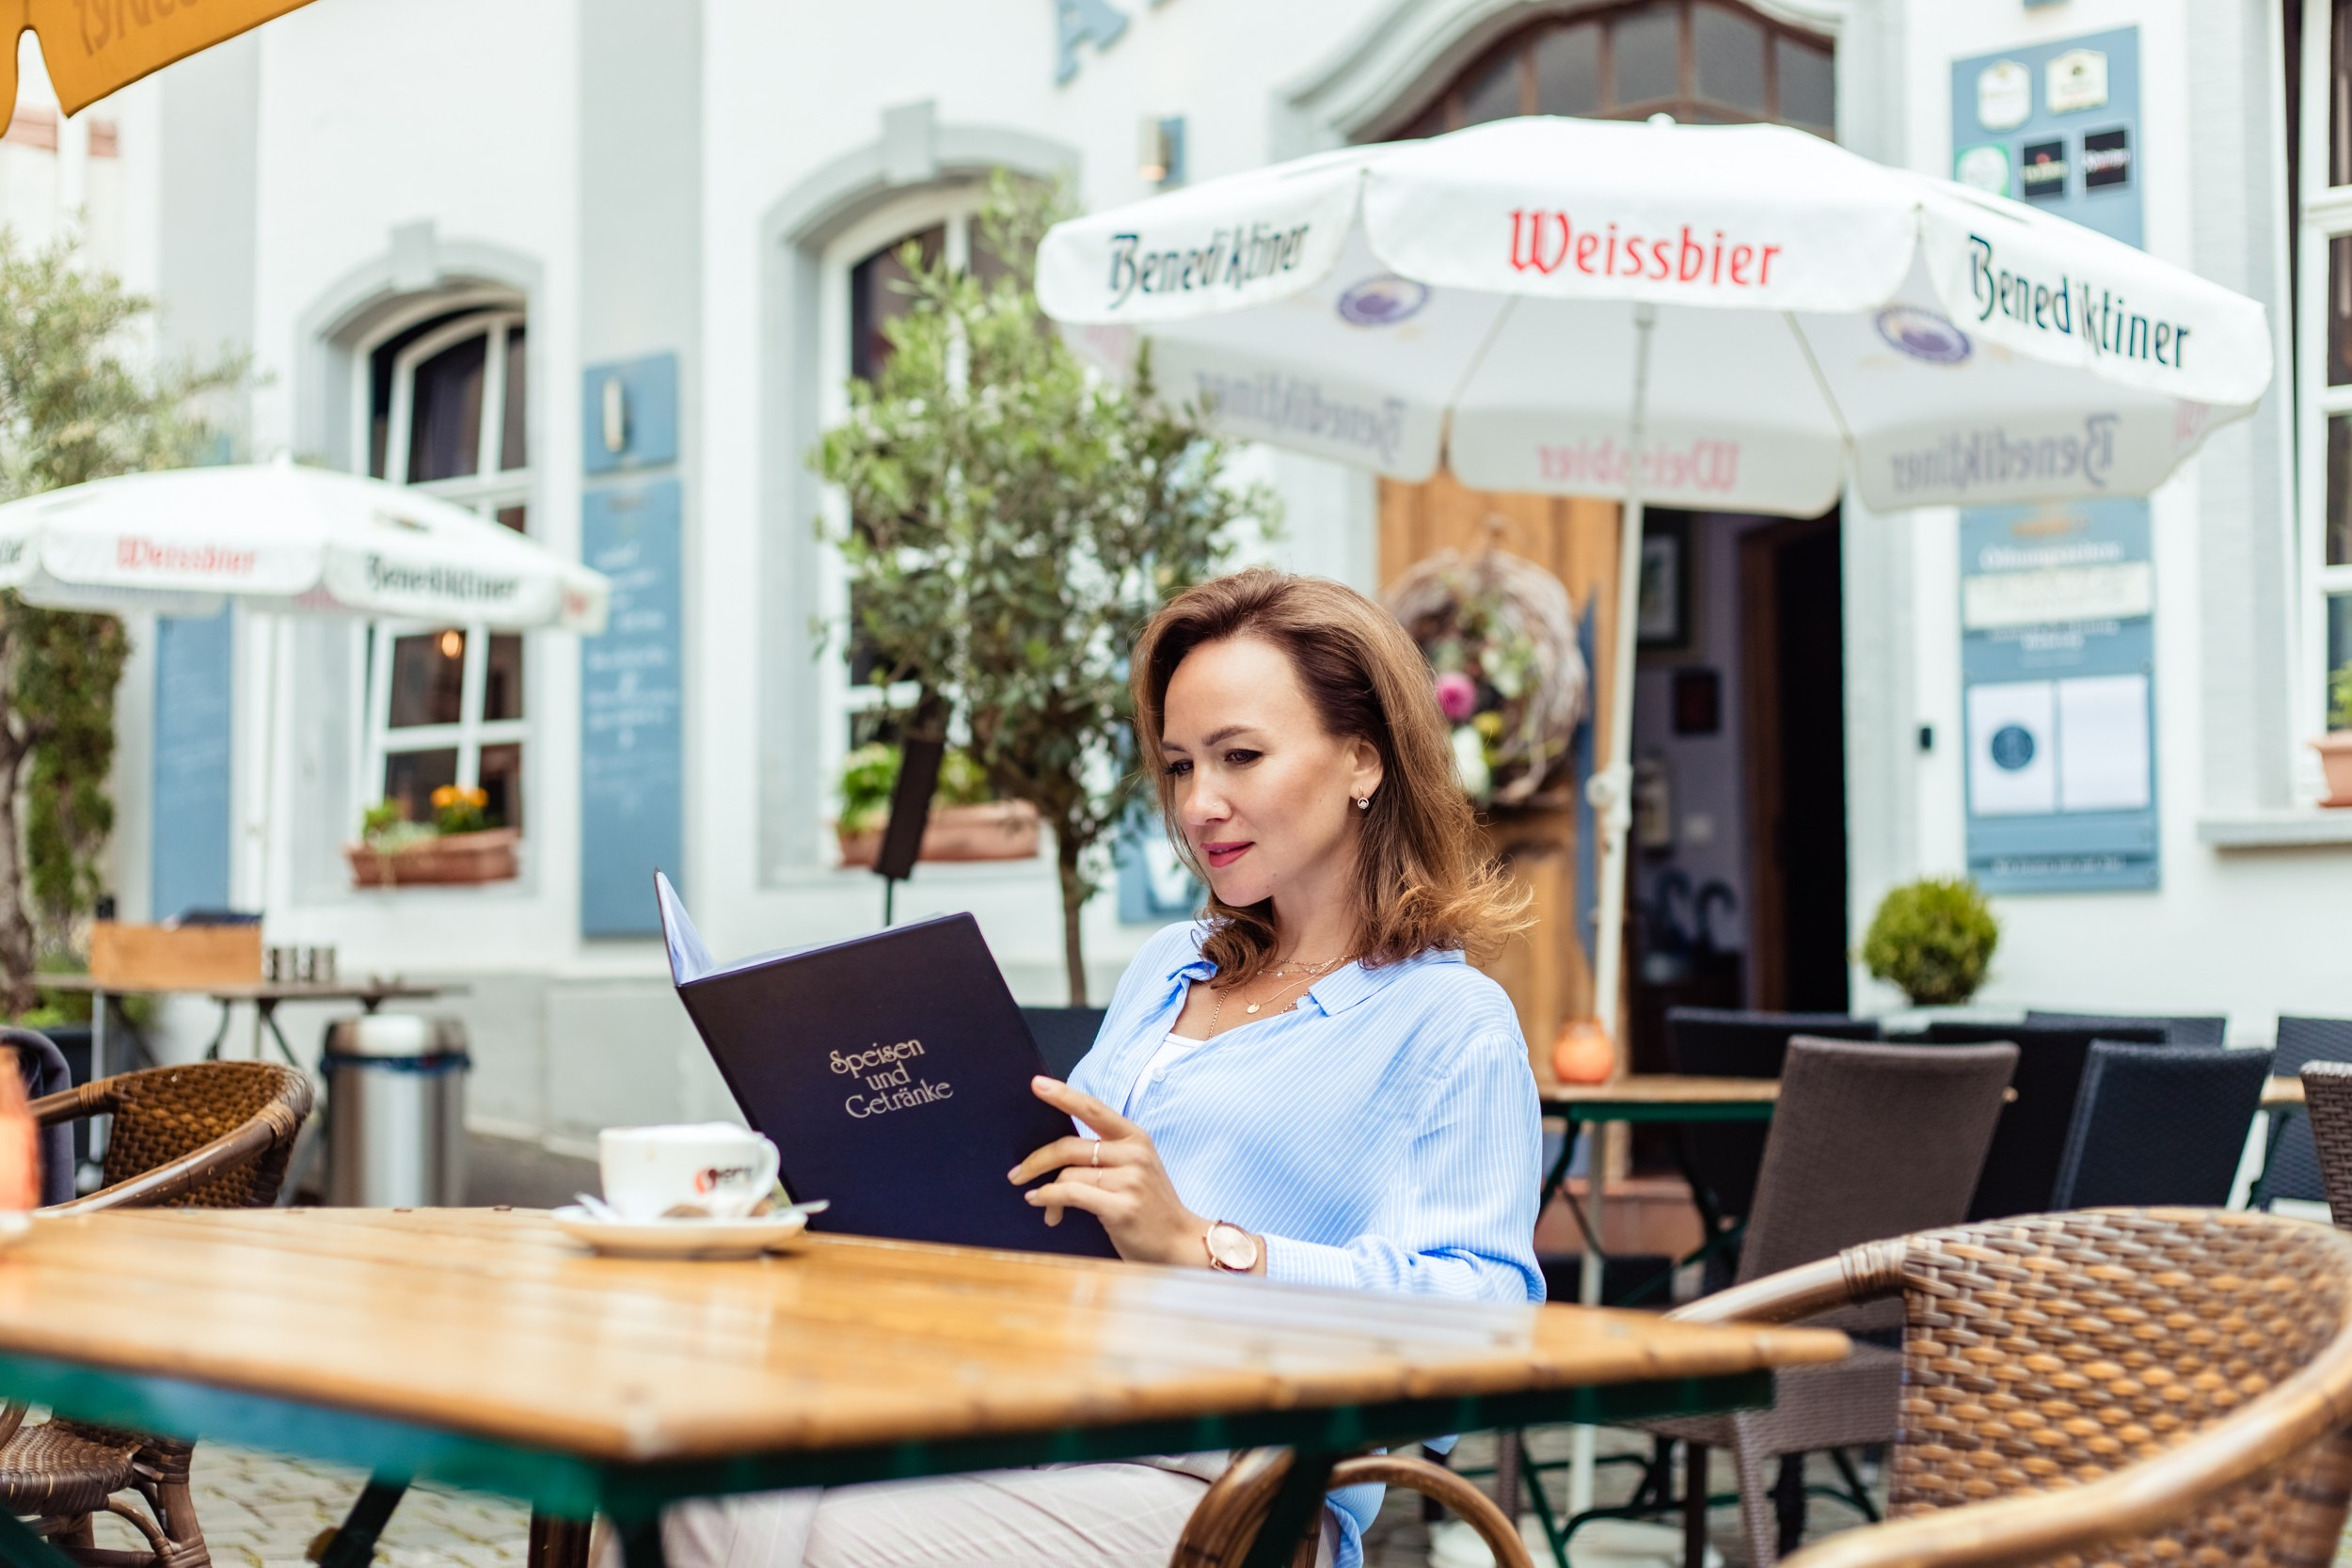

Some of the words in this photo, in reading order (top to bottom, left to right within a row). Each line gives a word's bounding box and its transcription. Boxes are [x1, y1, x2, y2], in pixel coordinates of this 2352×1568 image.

[1108, 223, 1311, 309] Benediktiner
[1509, 208, 1781, 286] Weissbier
[1969, 233, 2191, 369] Benediktiner
[829, 1037, 927, 1080] Speisen
[865, 1059, 913, 1092] und
[845, 1078, 955, 1119] Getränke
